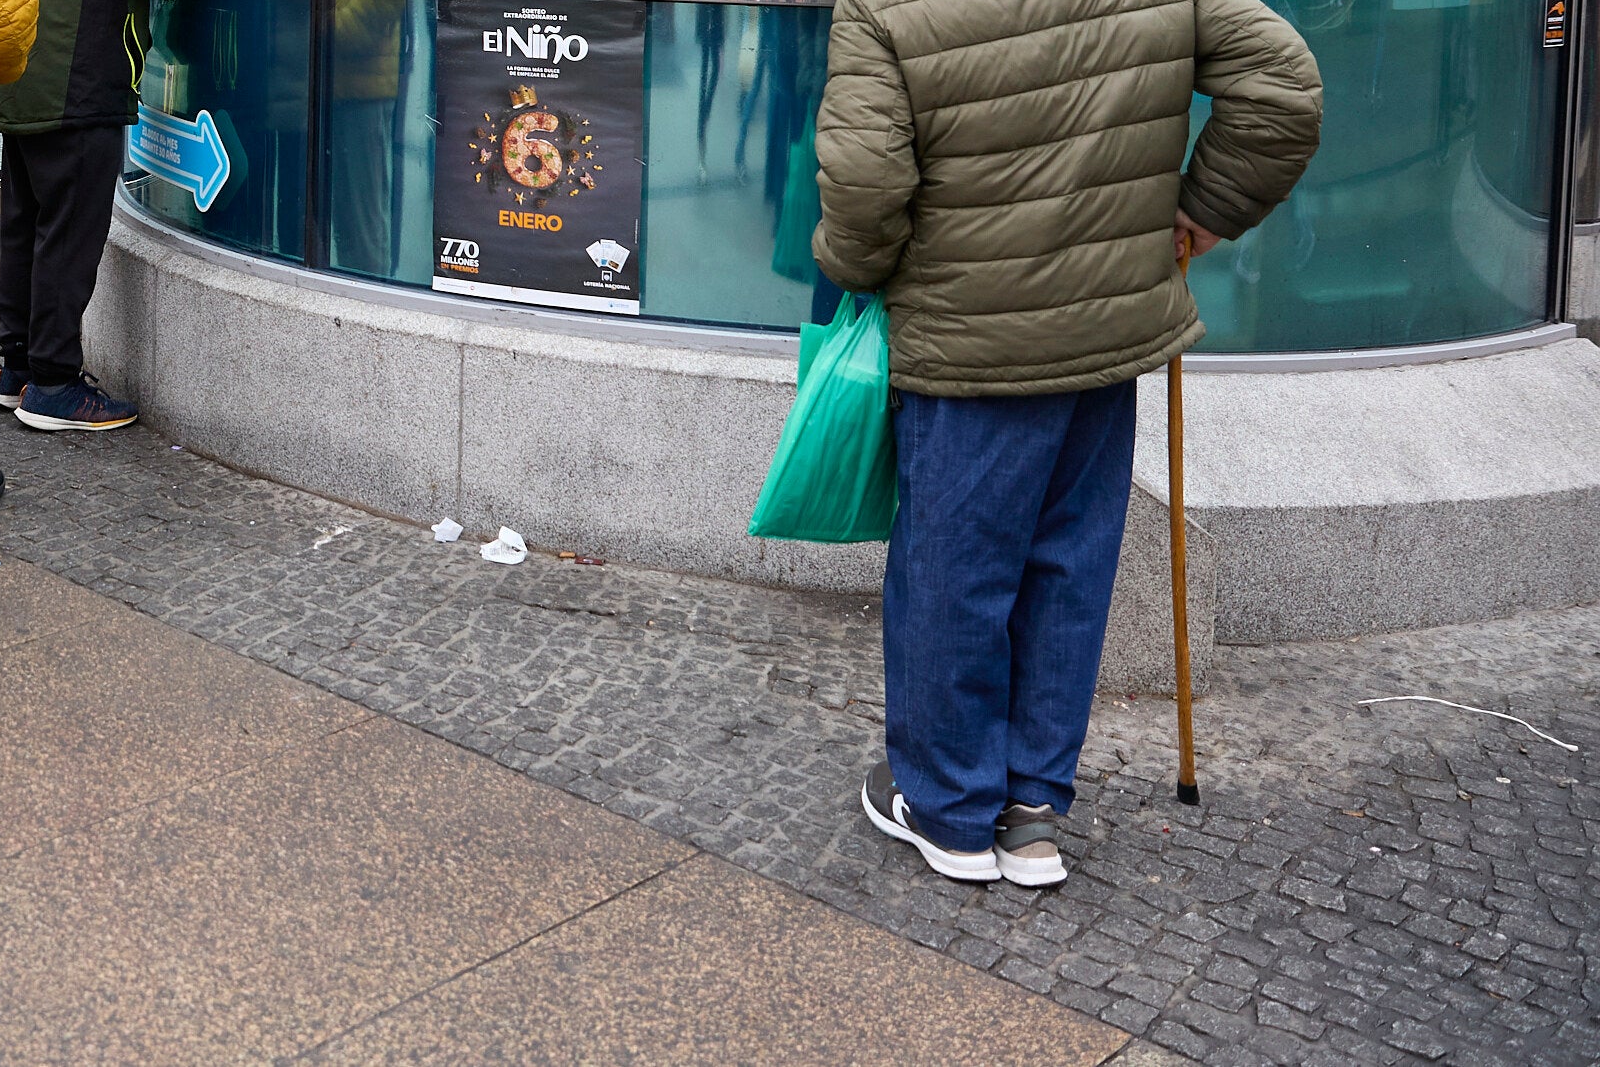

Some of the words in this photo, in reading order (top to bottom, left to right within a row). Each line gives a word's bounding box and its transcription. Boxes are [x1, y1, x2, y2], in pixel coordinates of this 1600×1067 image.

[504, 12, 557, 20] EXTRAORDINARIO
[482, 27, 502, 53] El
[506, 24, 589, 65] Niño
[498, 210, 563, 232] ENERO
[440, 237, 480, 259] 770
[440, 256, 479, 268] MILLONES
[451, 264, 479, 274] PREMIOS
[583, 280, 603, 288] LOTERÍA
